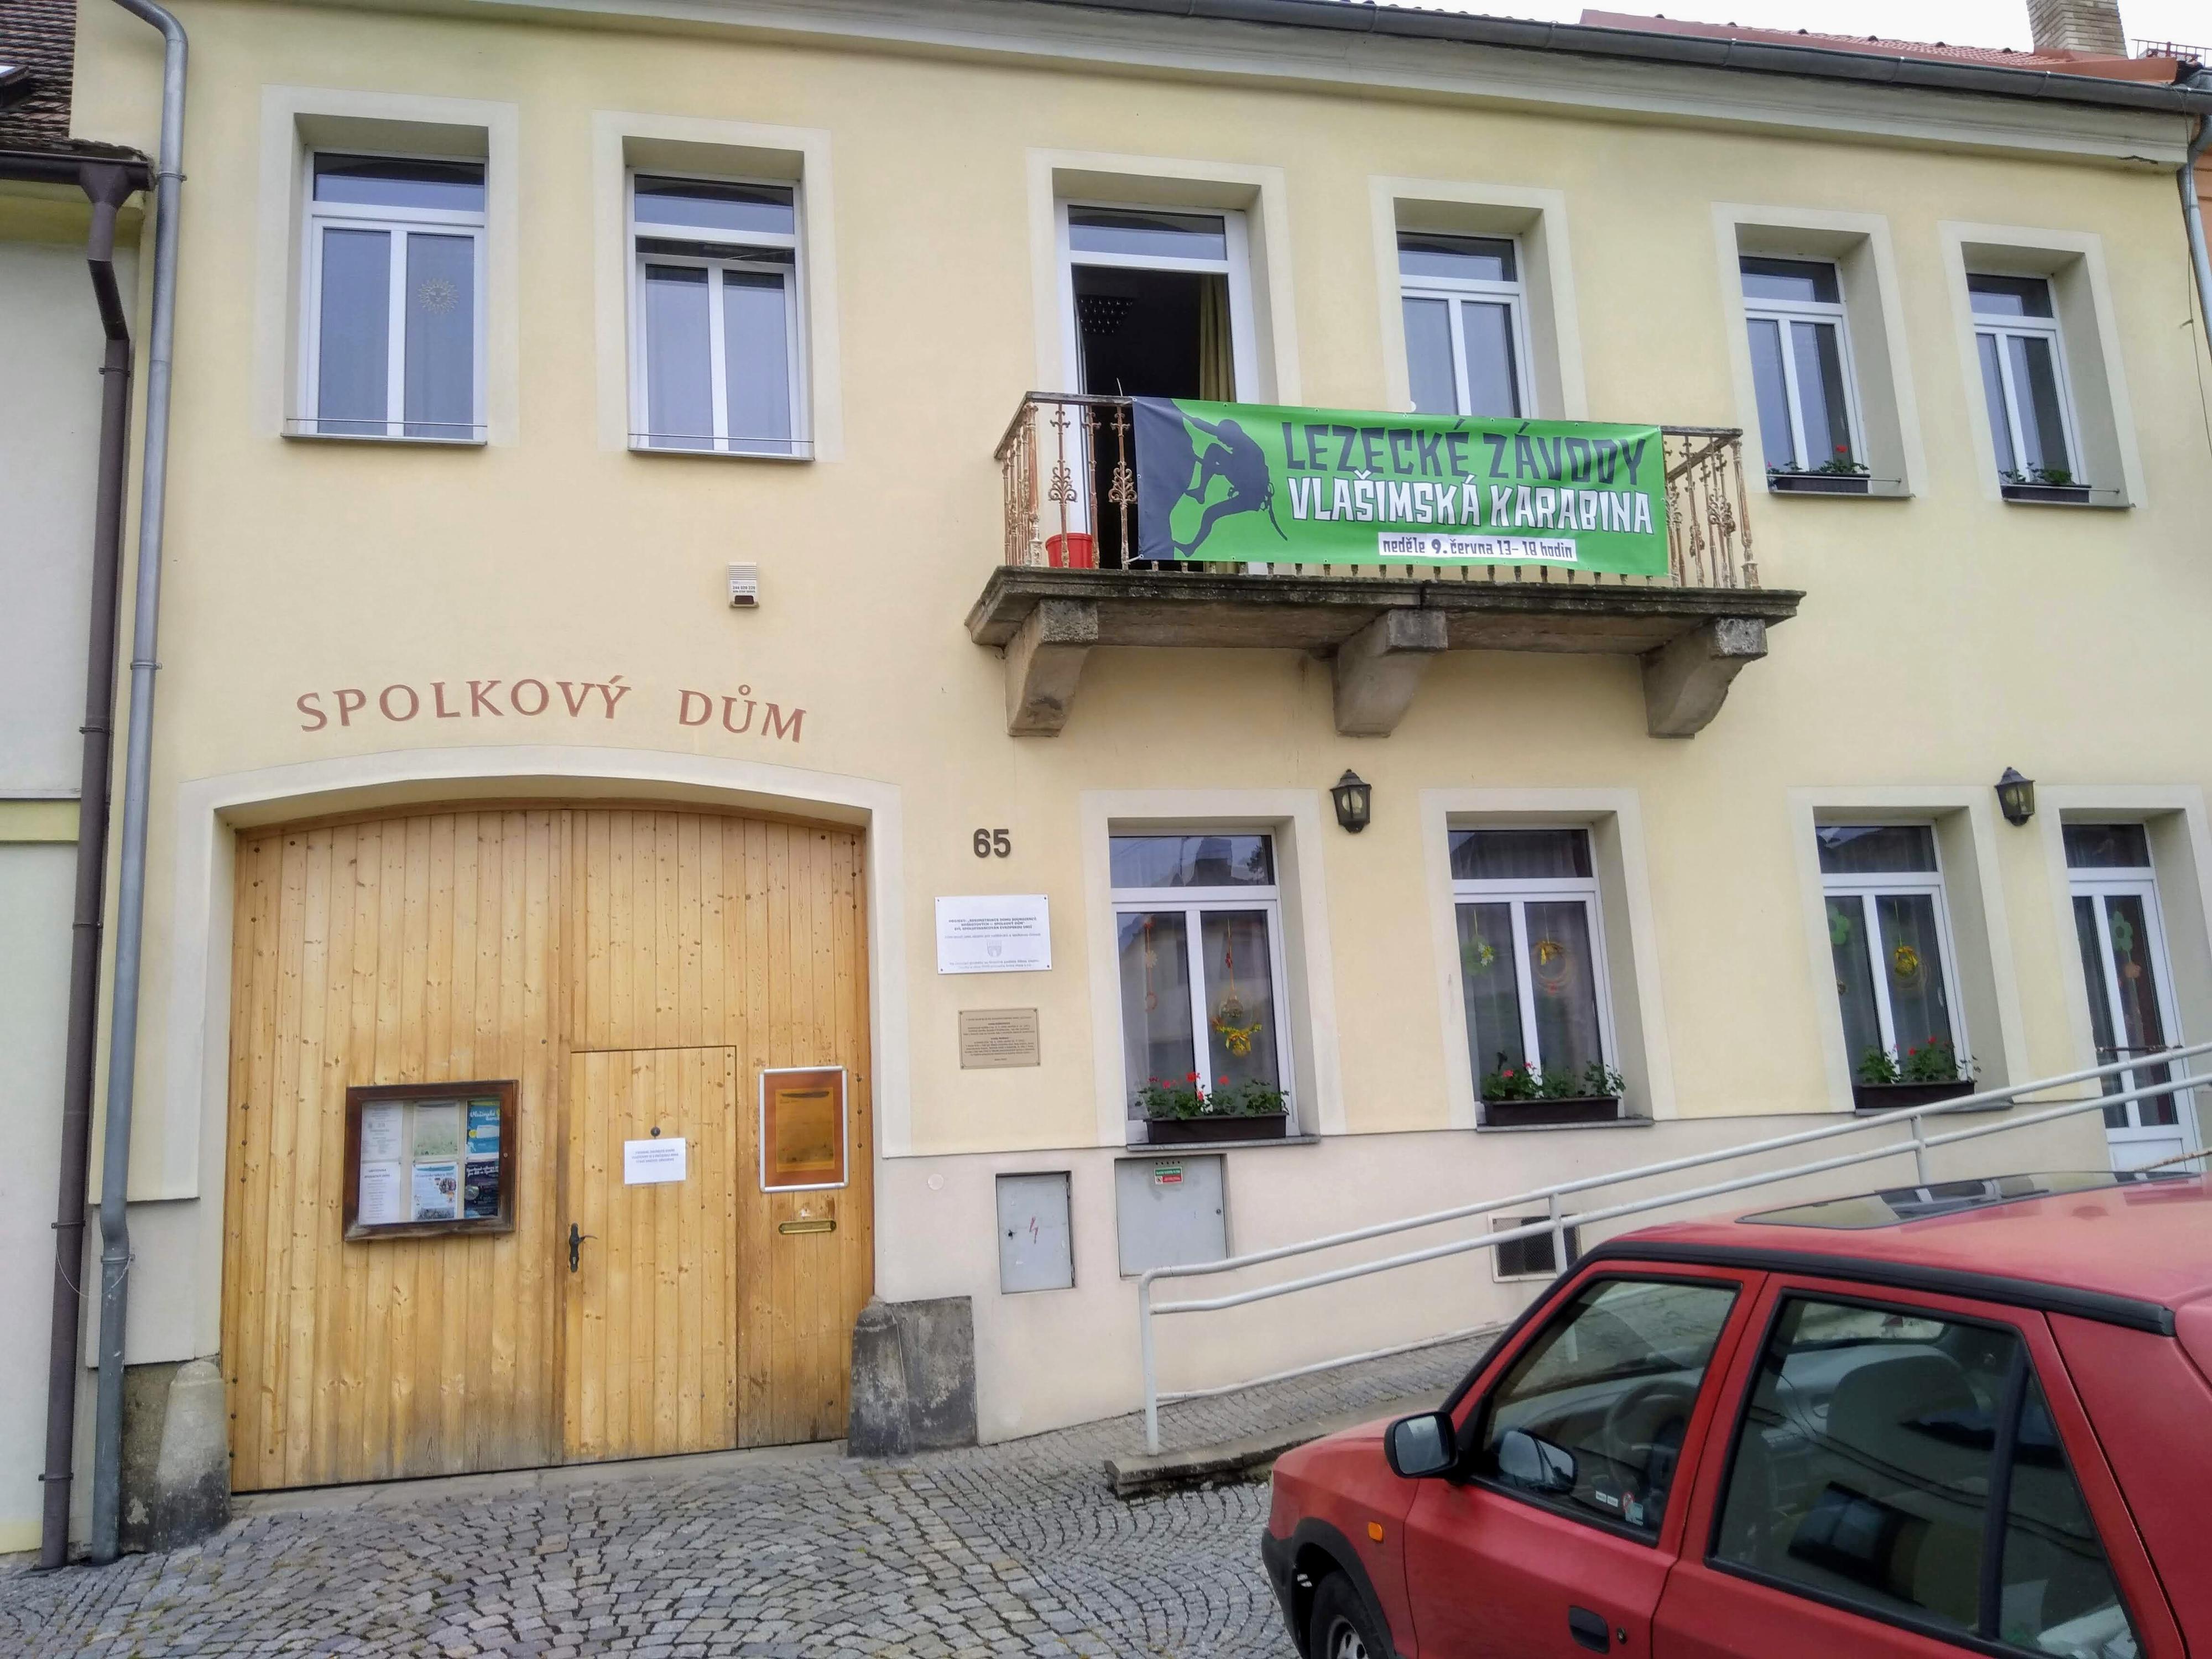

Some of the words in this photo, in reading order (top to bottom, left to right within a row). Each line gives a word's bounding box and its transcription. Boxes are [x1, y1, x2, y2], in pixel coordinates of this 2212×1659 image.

[1282, 419, 1469, 476] LEZECKÉ
[1483, 422, 1645, 485] ZÁVODY
[1286, 469, 1481, 528] VLAŠIMSKÁ
[1490, 483, 1654, 535] KARABINA
[1383, 537, 1425, 554] neděle
[1431, 539, 1447, 554] 9.
[1450, 538, 1494, 555] června
[1522, 540, 1536, 556] 18
[1540, 542, 1573, 558] hodin
[297, 675, 632, 732] SPOLKOVÝ
[678, 684, 807, 743] DŮM
[973, 828, 1011, 858] 65
